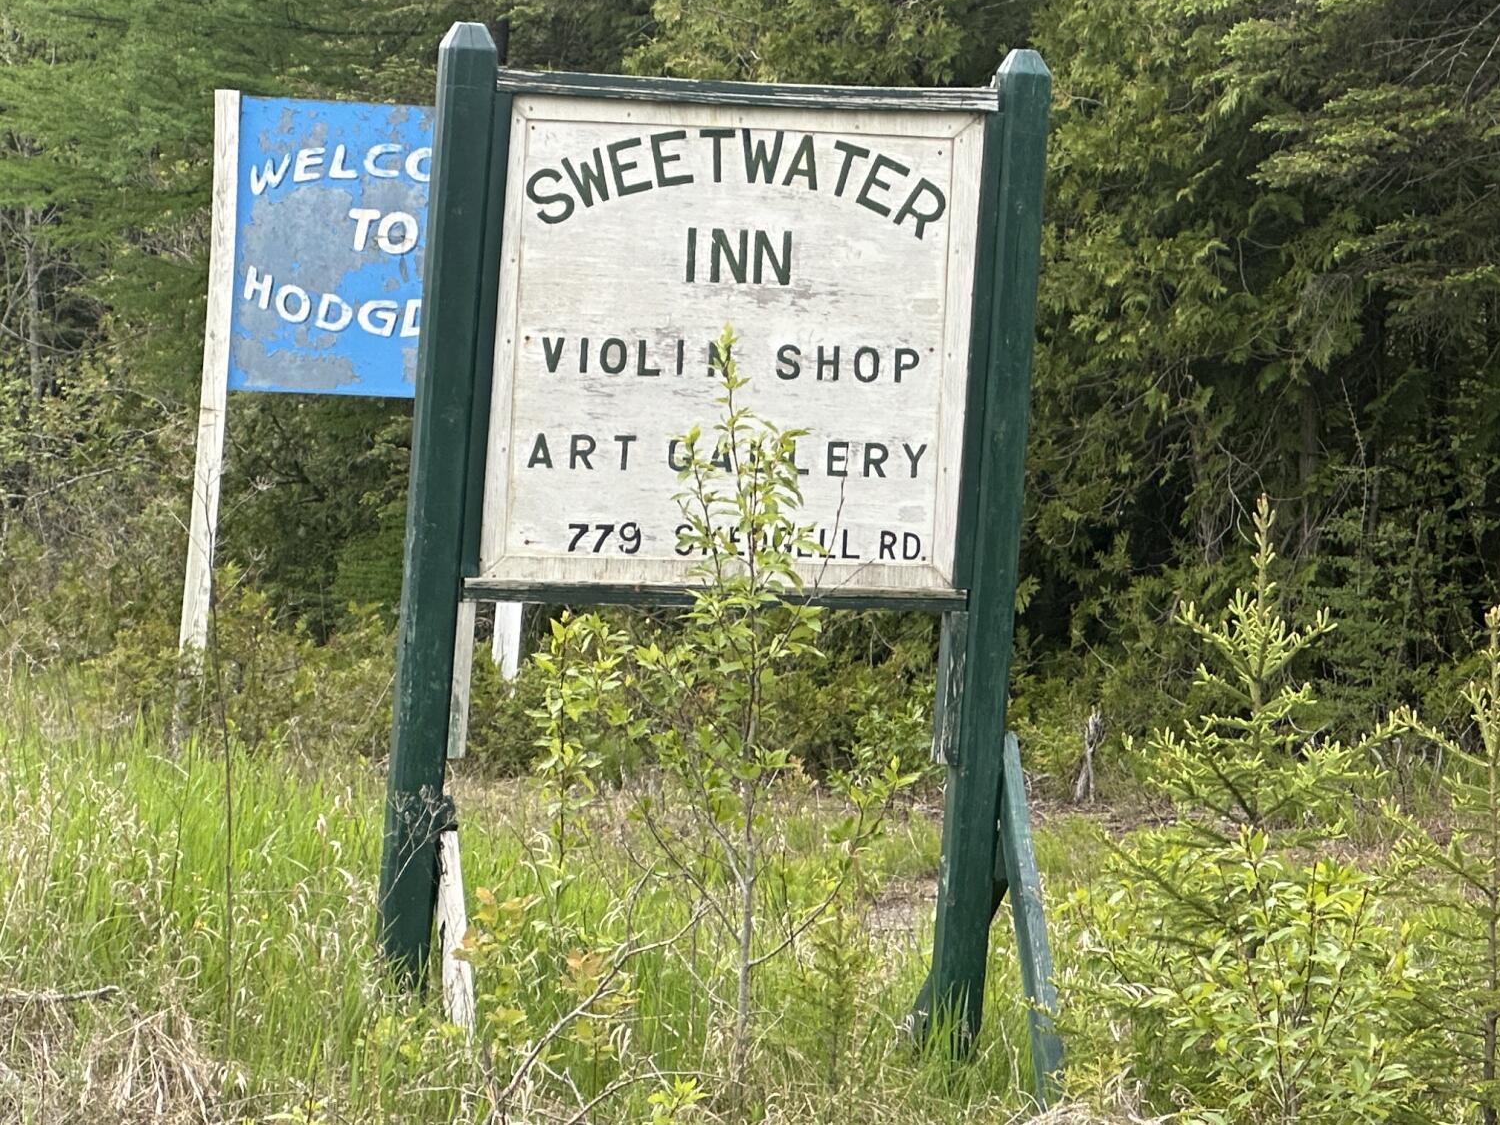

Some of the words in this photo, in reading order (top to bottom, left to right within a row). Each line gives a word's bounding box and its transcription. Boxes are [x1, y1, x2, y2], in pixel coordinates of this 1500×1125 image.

[525, 128, 947, 240] SWEETWATER
[349, 208, 419, 254] TO
[685, 227, 793, 286] INN
[542, 337, 732, 377] VIOLIN
[775, 344, 921, 383] SHOP
[527, 433, 637, 471] ART
[567, 522, 642, 554] 779
[879, 530, 927, 562] RD.
